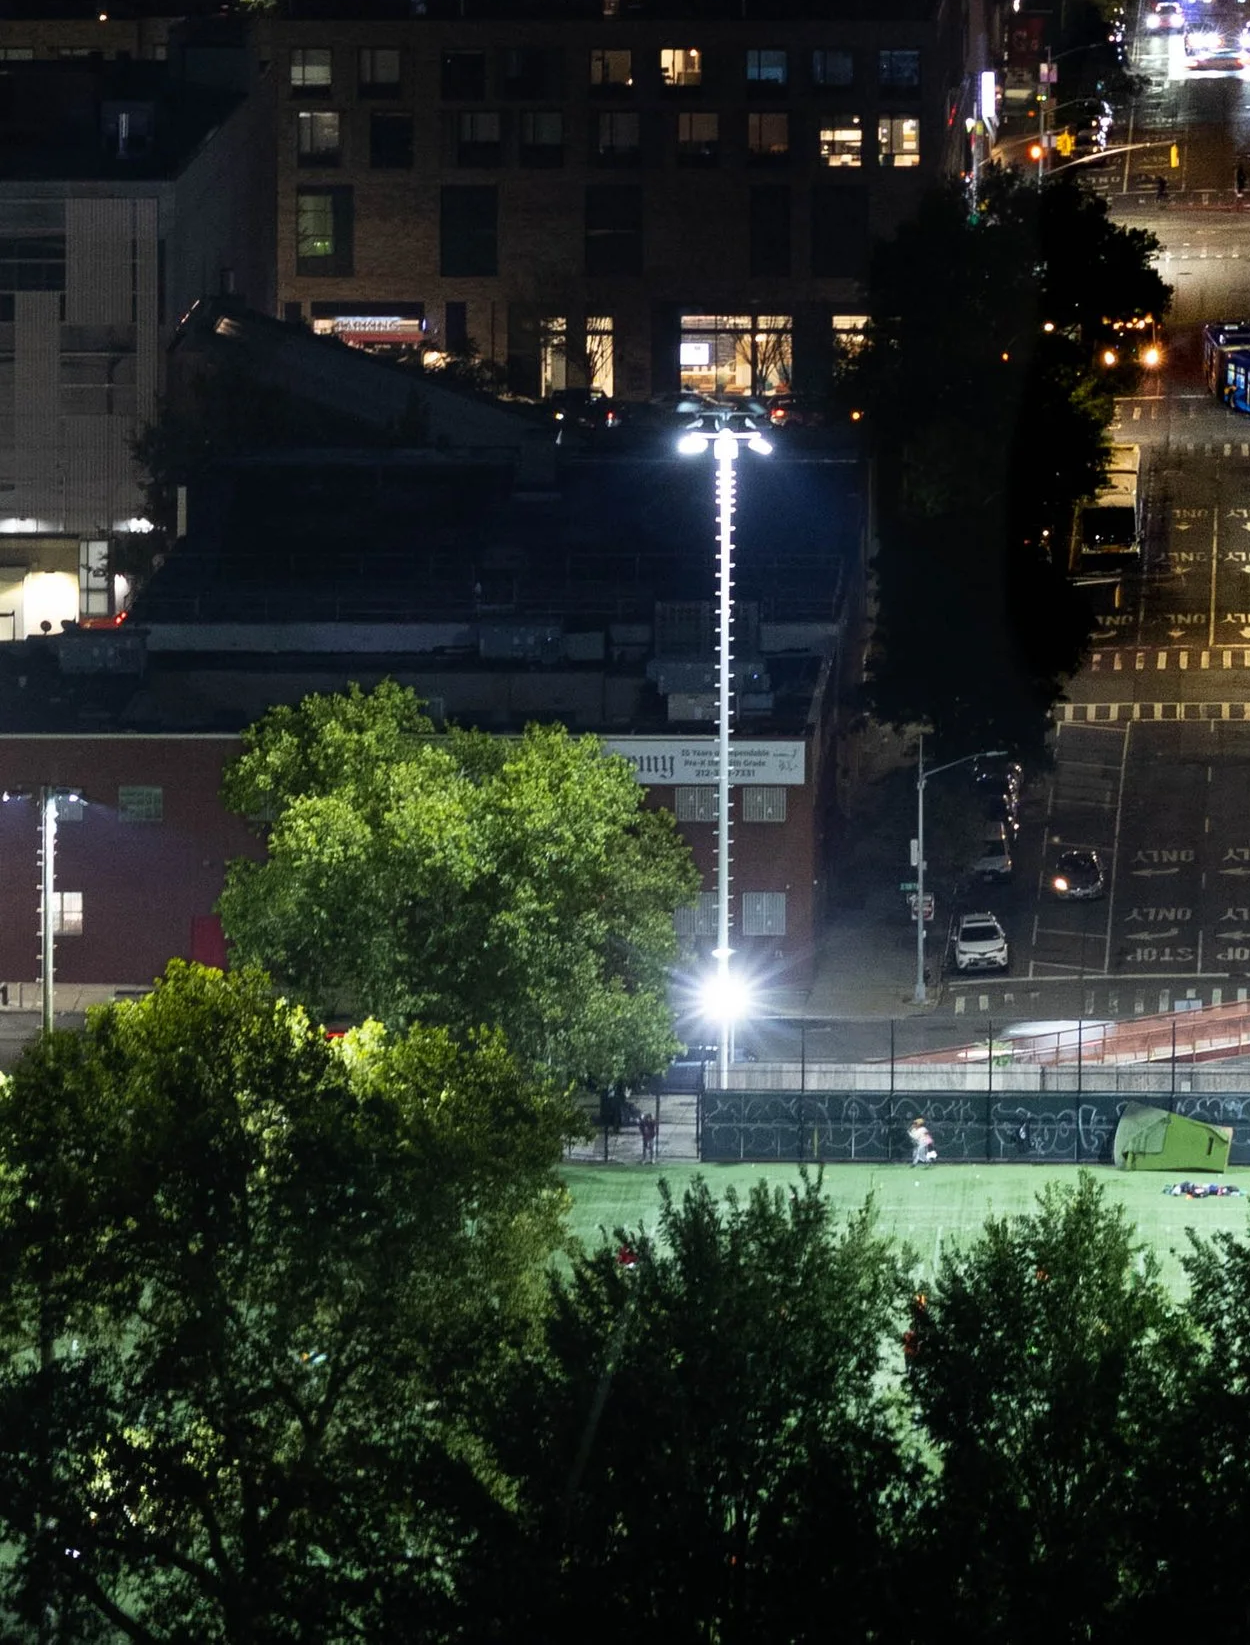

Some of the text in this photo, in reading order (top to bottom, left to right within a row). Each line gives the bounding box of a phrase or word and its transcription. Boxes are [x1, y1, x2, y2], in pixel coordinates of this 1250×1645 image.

[727, 748, 769, 758] ependable
[743, 759, 766, 767] Grade
[1133, 849, 1195, 862] ONLY
[1124, 907, 1192, 922] ONLY
[1127, 947, 1194, 962] STOP
